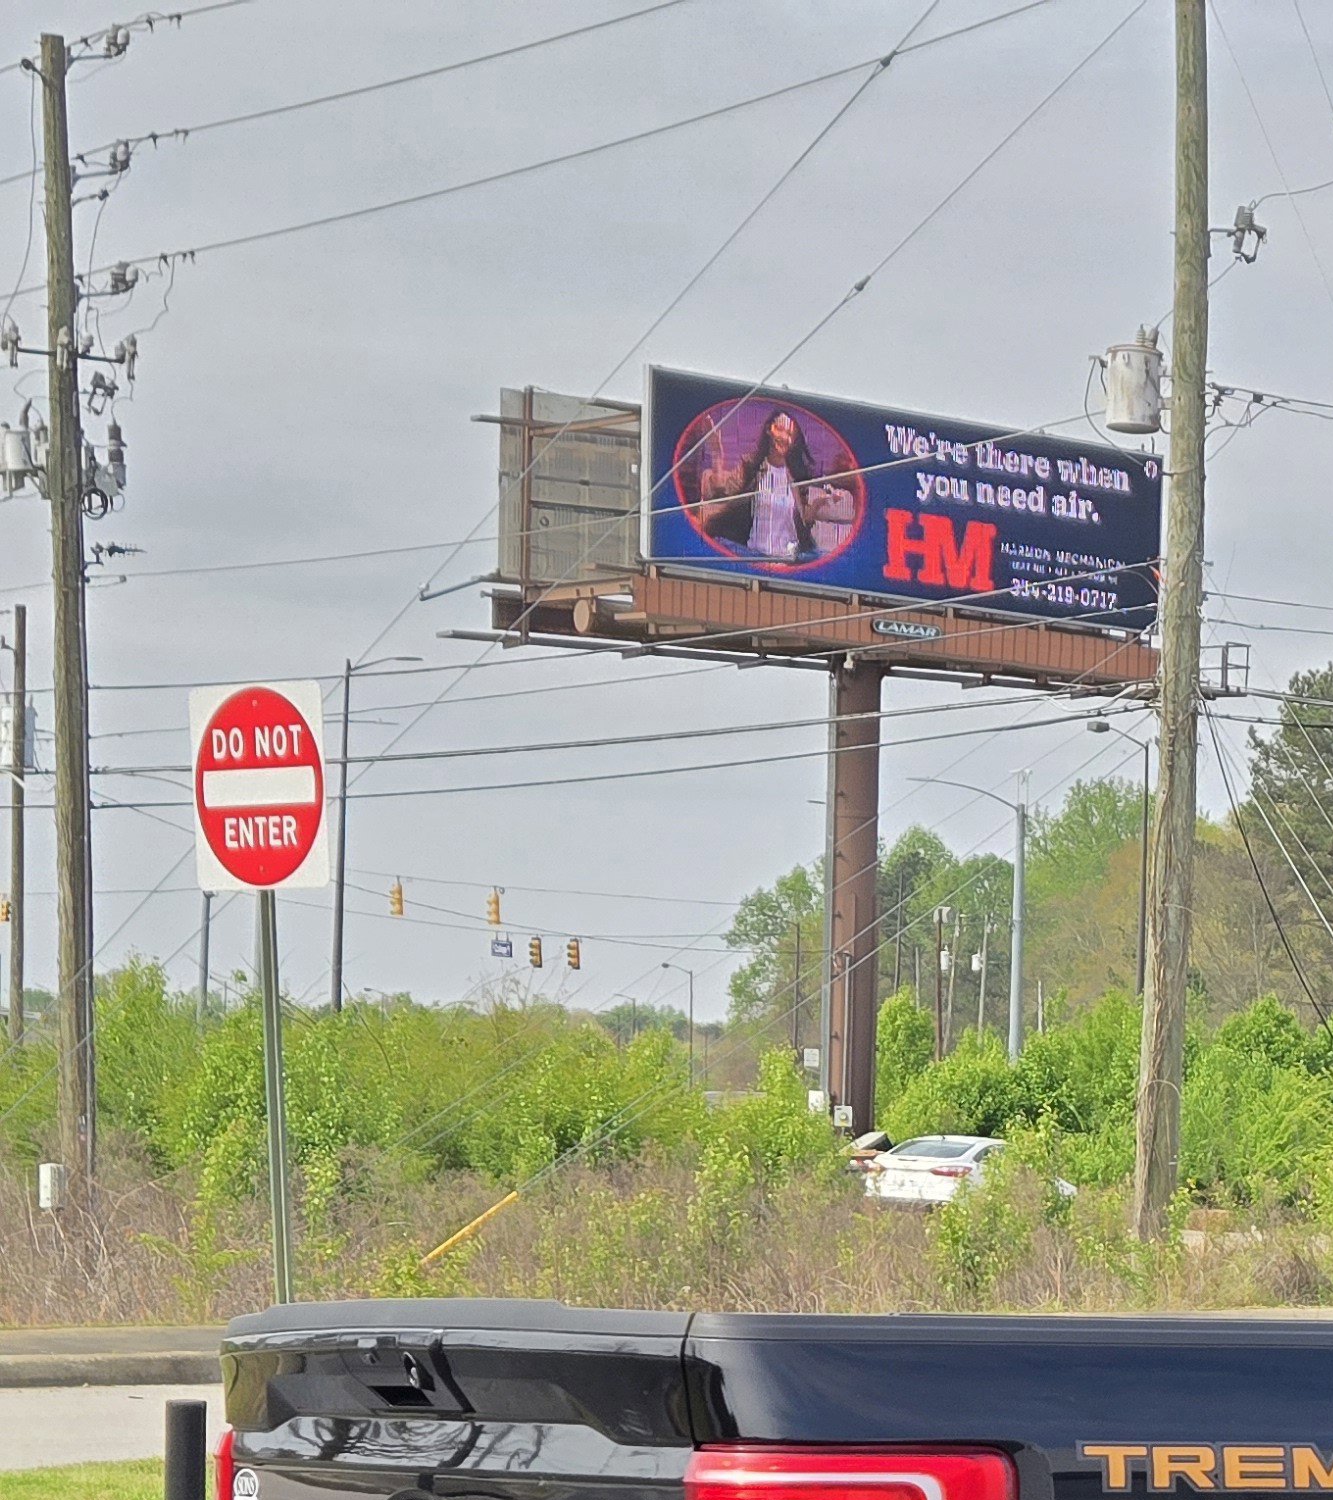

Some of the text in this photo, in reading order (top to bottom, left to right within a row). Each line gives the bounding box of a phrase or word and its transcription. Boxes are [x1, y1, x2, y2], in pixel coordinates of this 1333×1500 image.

[885, 424, 1130, 491] We're there when
[916, 472, 1100, 523] you need air.
[883, 508, 997, 591] HM
[878, 621, 937, 637] LAMAR
[211, 724, 302, 760] DO NOT
[224, 815, 298, 849] ENTER
